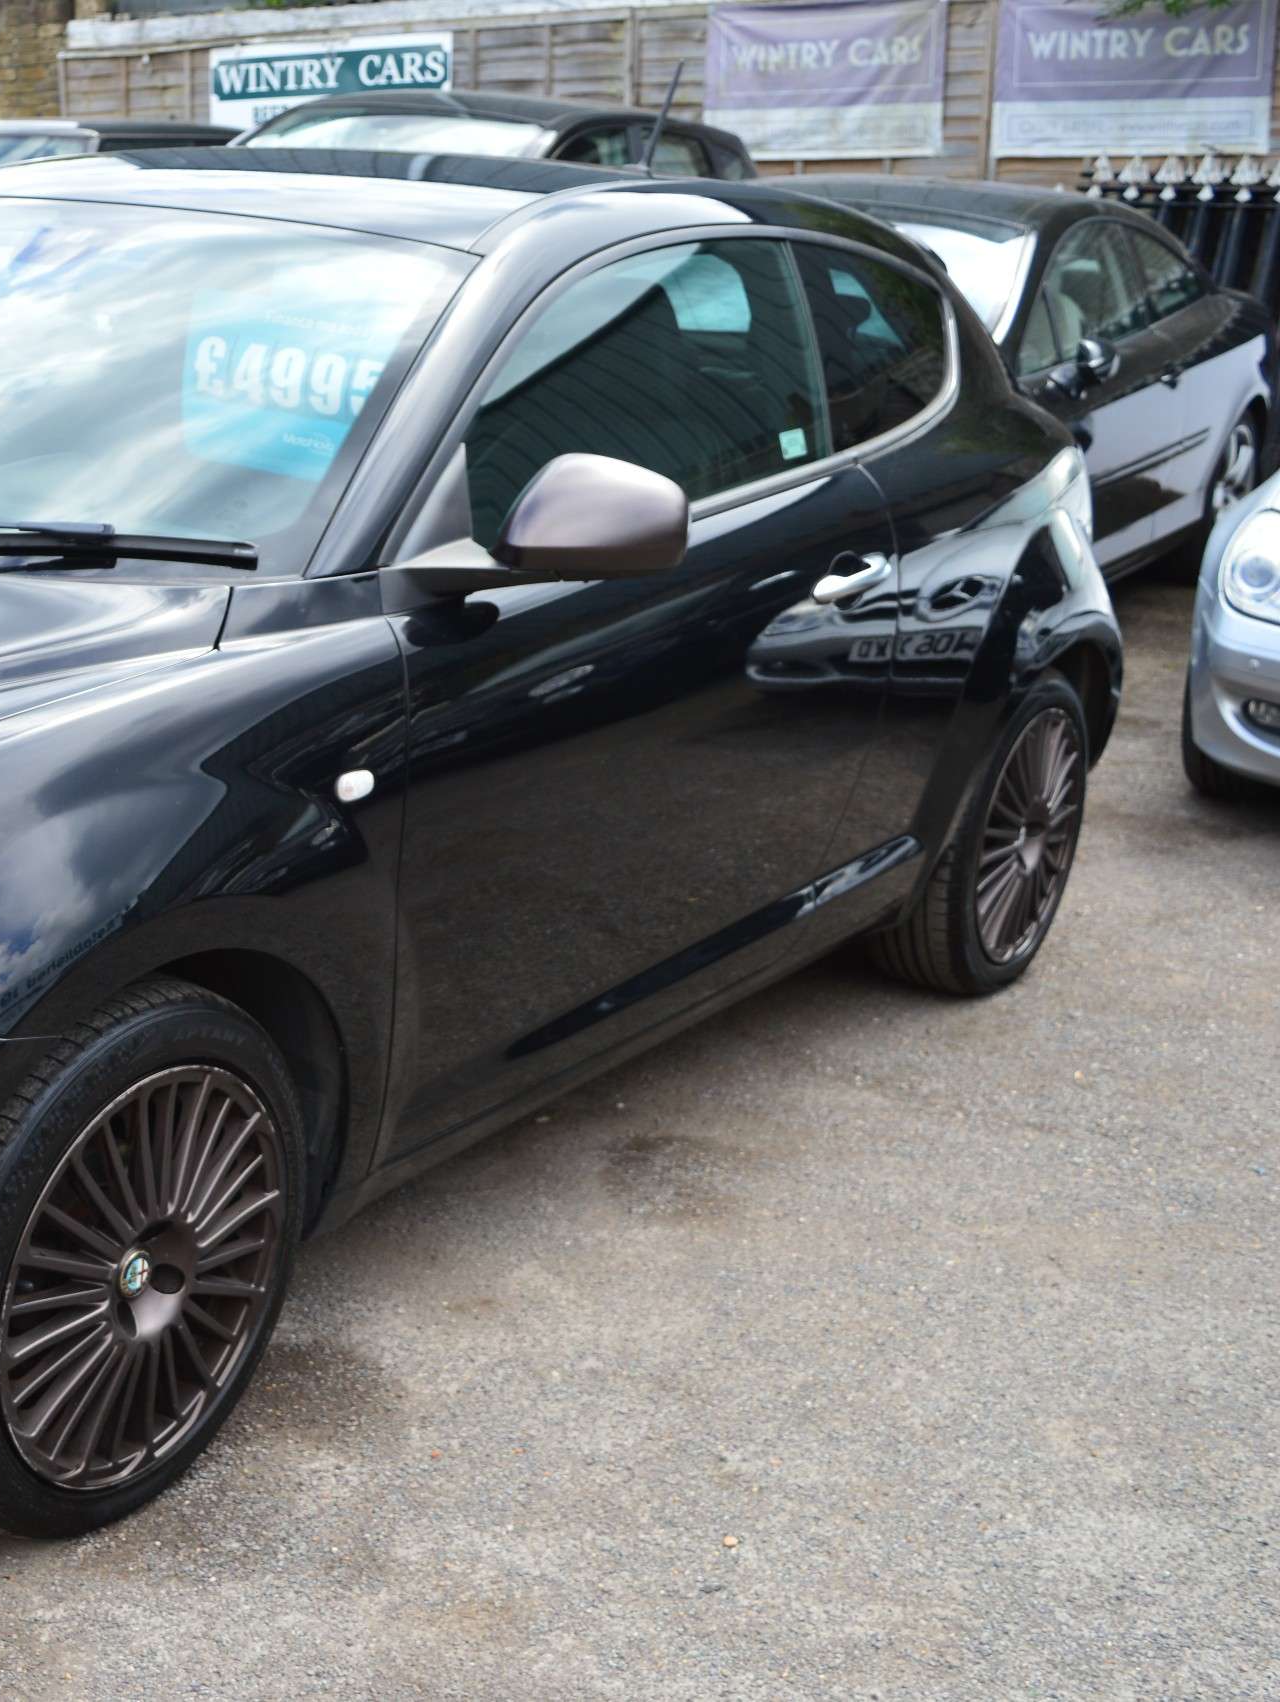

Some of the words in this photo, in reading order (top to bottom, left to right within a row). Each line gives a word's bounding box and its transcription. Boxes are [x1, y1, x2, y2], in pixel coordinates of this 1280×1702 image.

[731, 40, 841, 72] WINTRY
[848, 35, 924, 67] CARS
[1027, 27, 1155, 60] WINTRY
[1163, 23, 1250, 58] CARS
[216, 57, 345, 95] WINTRY
[358, 50, 447, 87] CARS
[193, 336, 384, 416] £4995
